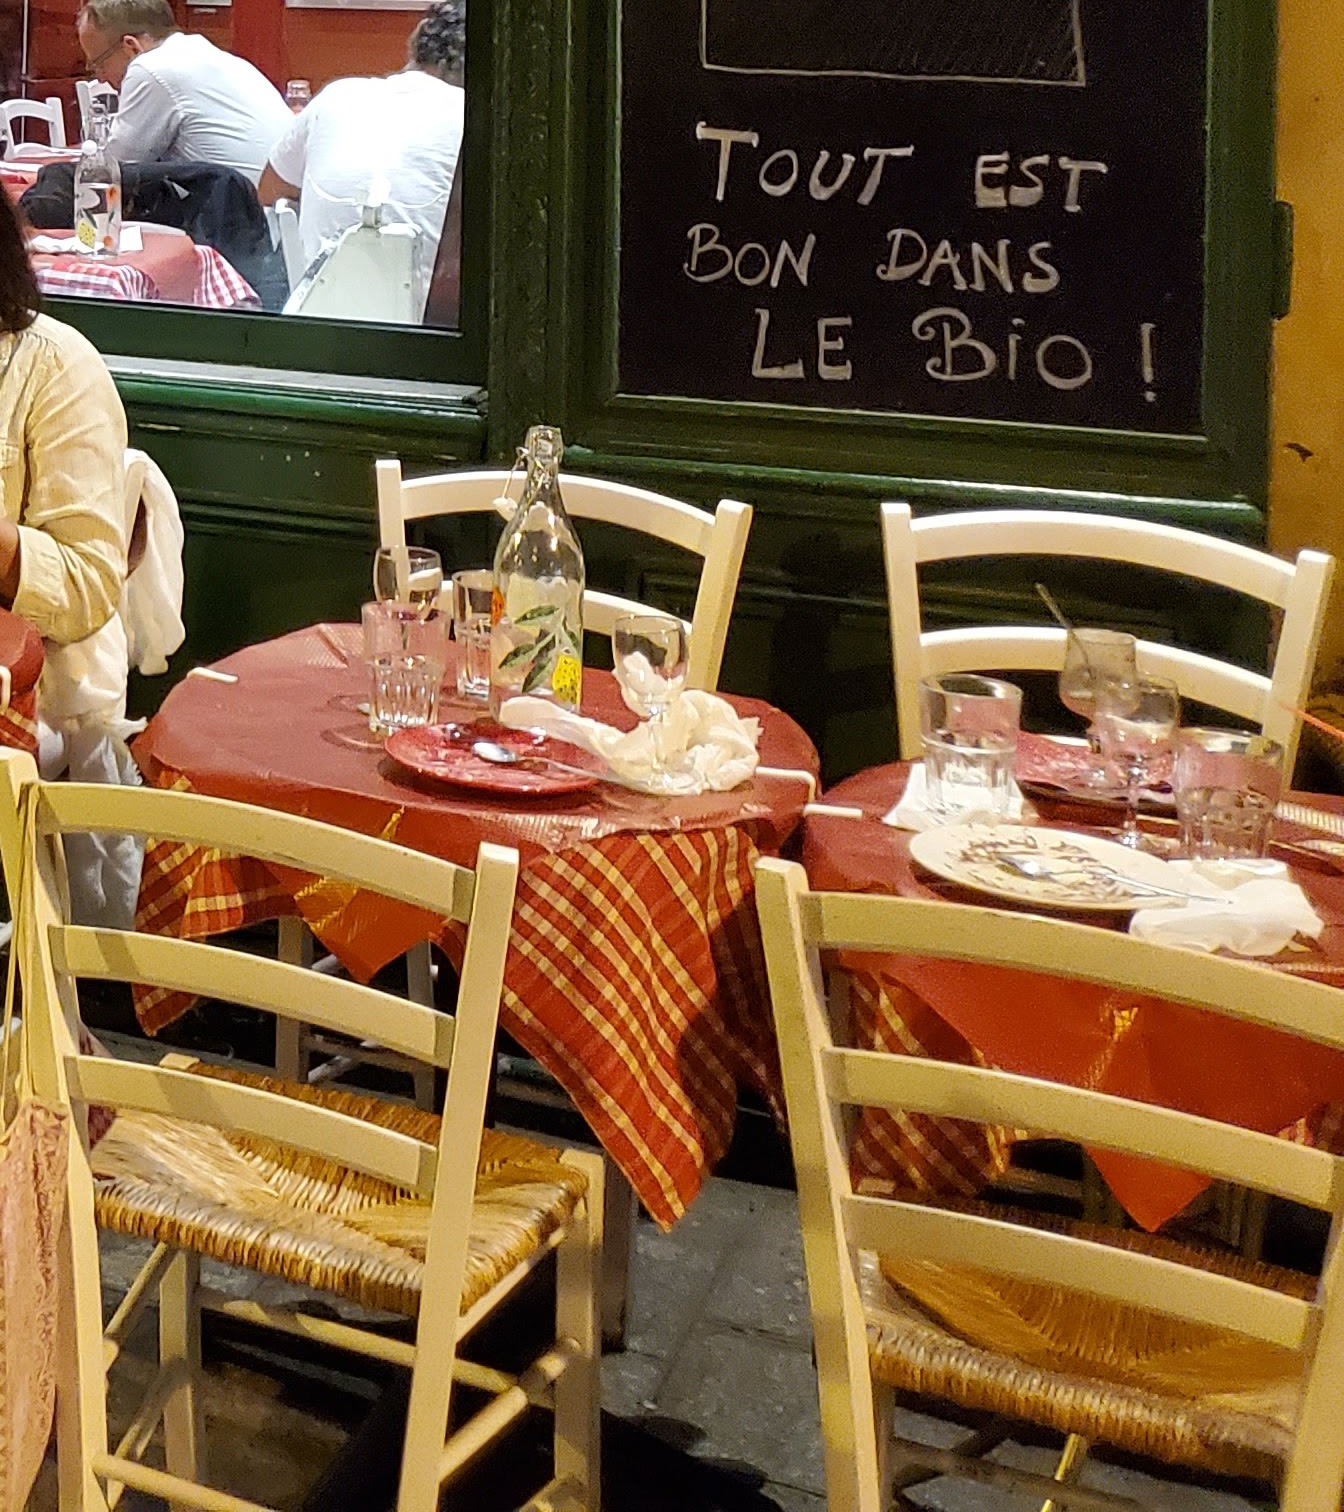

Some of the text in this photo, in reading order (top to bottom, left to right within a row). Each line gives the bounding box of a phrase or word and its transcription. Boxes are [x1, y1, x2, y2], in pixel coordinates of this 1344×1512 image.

[696, 121, 1108, 212] TOUT EST
[683, 223, 1060, 293] BON DANS
[752, 308, 852, 381] LE
